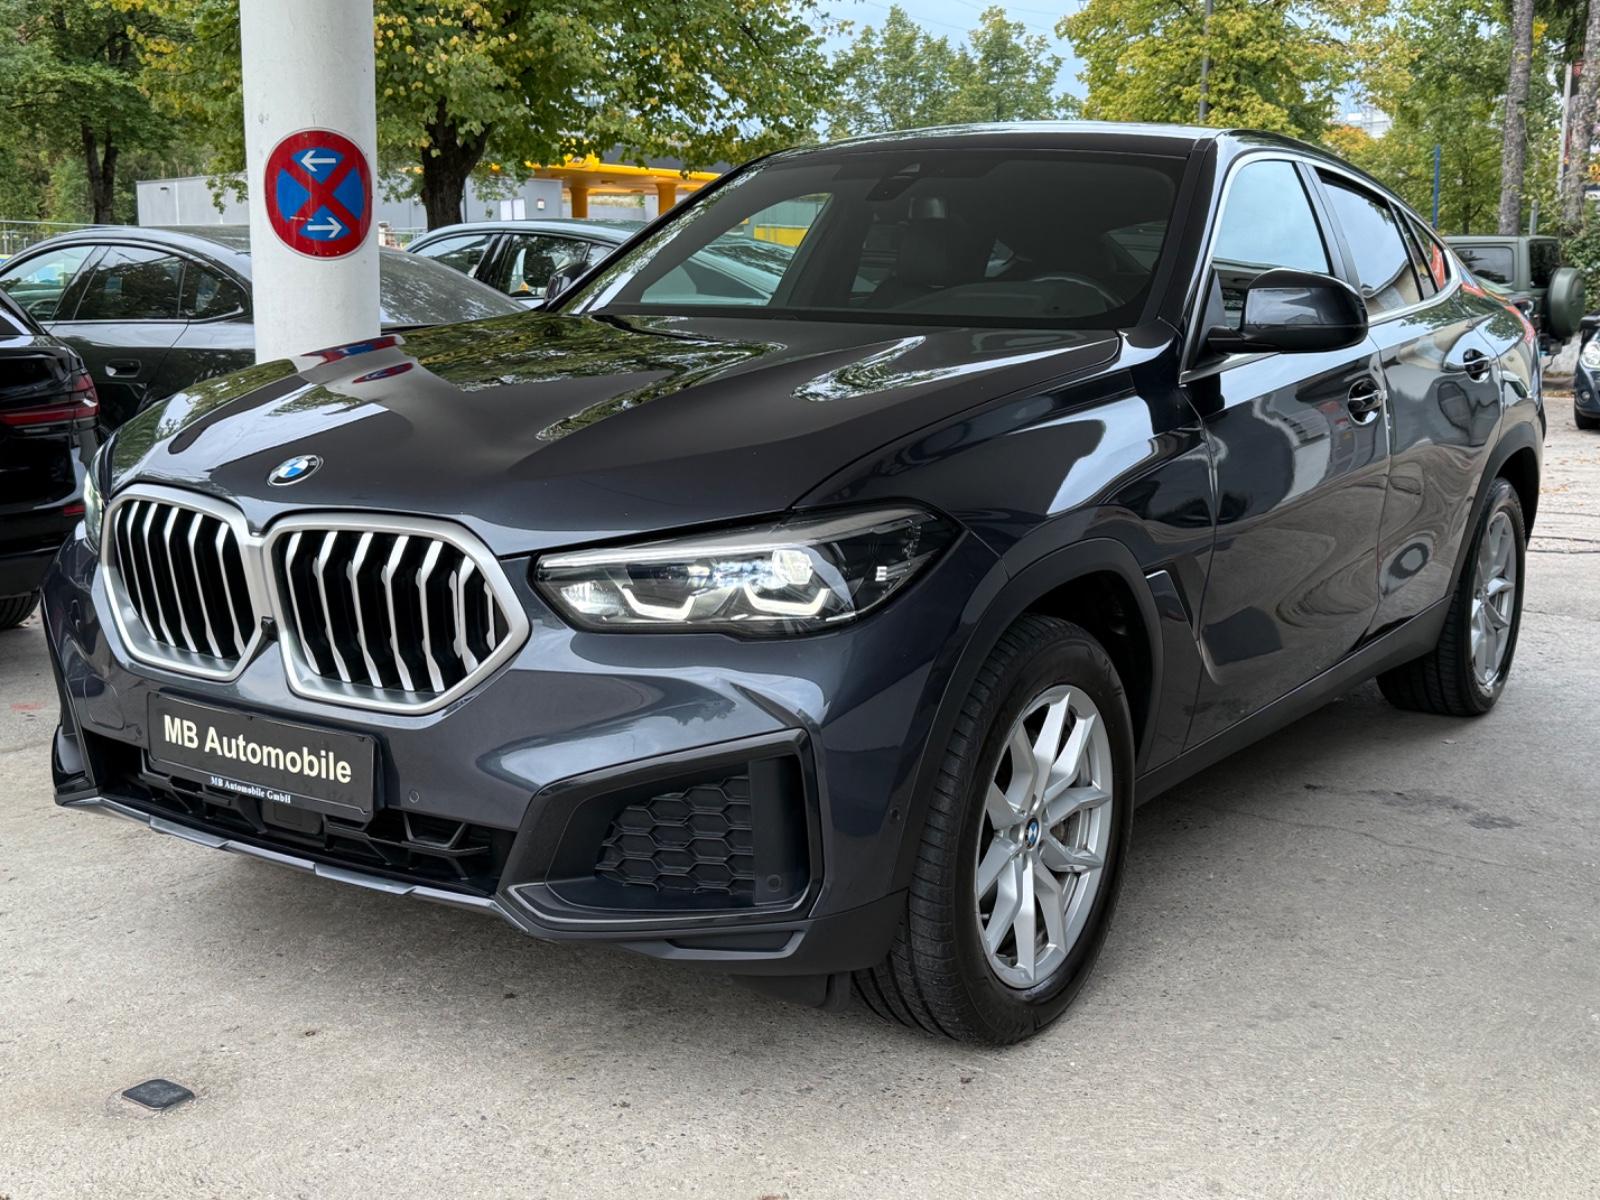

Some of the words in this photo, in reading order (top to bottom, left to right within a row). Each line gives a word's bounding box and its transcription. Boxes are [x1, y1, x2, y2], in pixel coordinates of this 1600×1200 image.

[163, 714, 199, 749] MB
[204, 726, 352, 784] Automobile
[210, 776, 224, 787] MB
[224, 780, 265, 798] Automobile
[266, 790, 291, 804] GmbH
